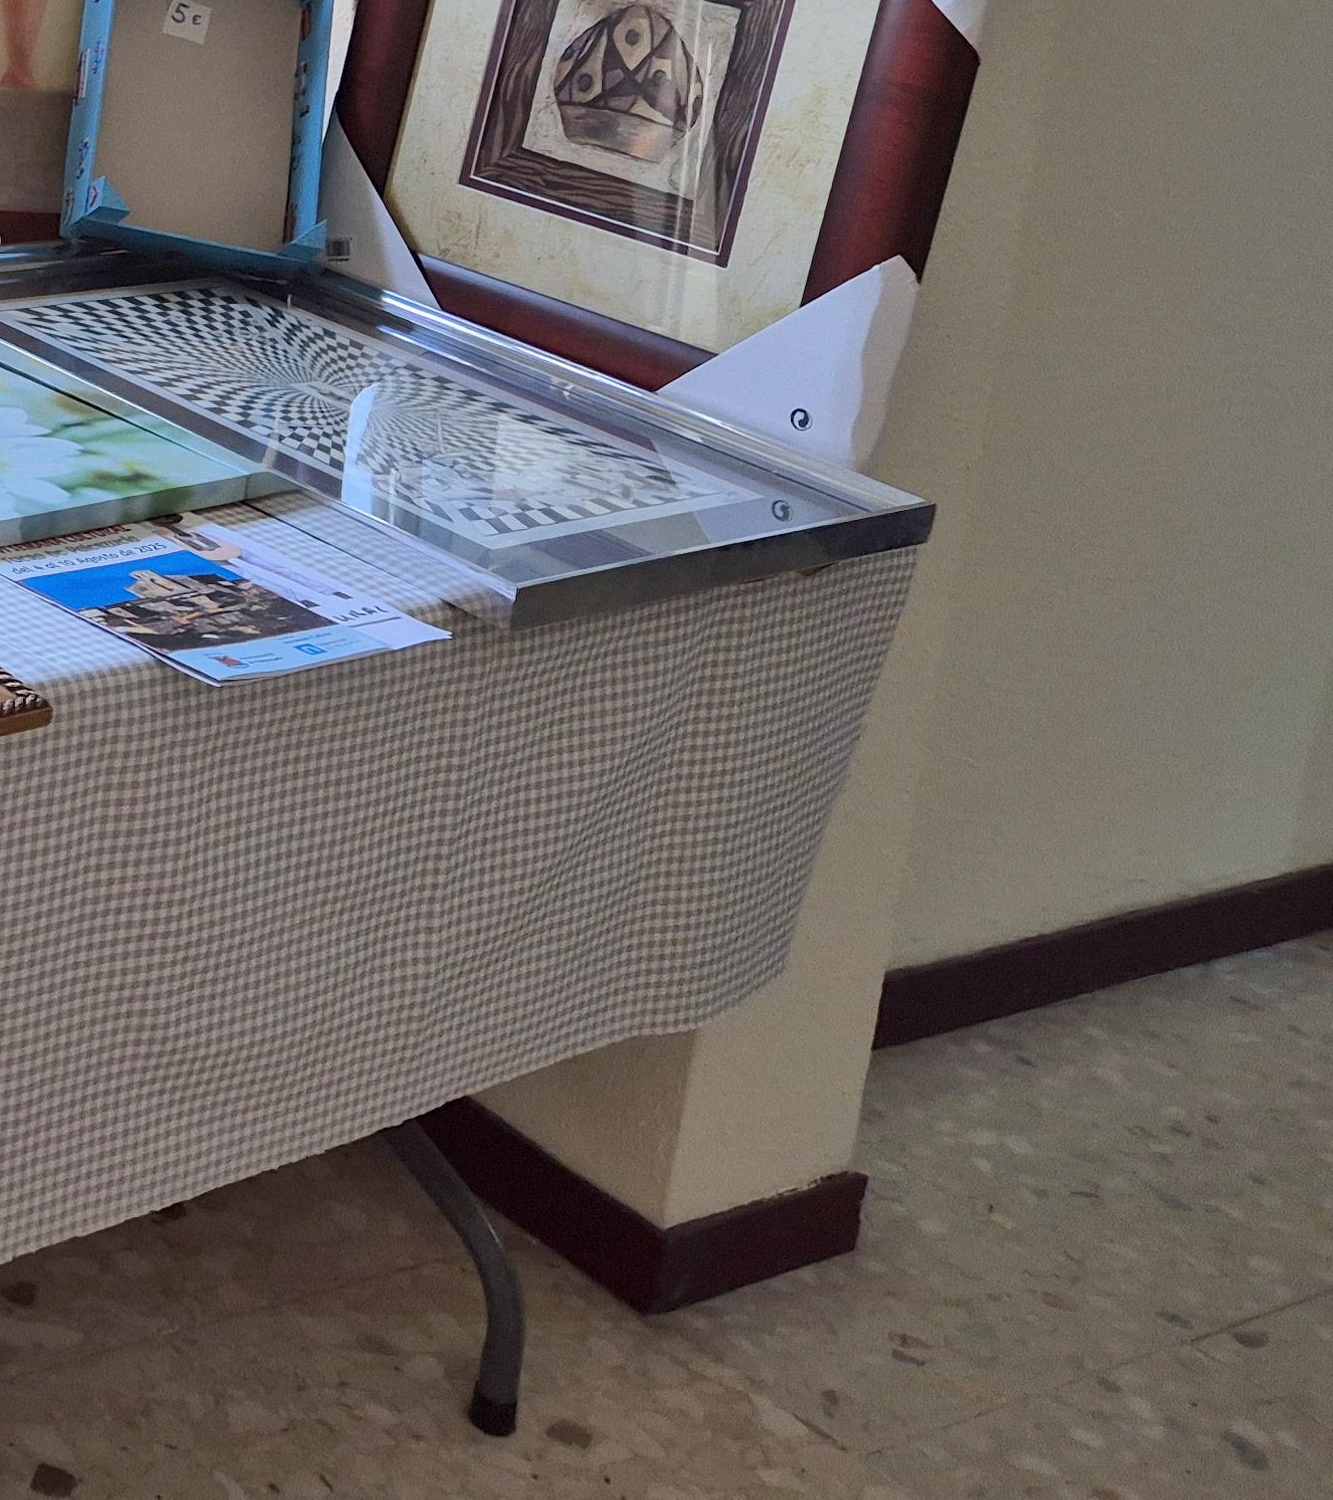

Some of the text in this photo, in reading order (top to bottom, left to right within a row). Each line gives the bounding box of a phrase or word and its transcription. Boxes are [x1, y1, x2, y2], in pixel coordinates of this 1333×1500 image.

[76, 552, 119, 564] Agosto
[135, 541, 168, 554] 2025
[332, 604, 389, 623] URAL
